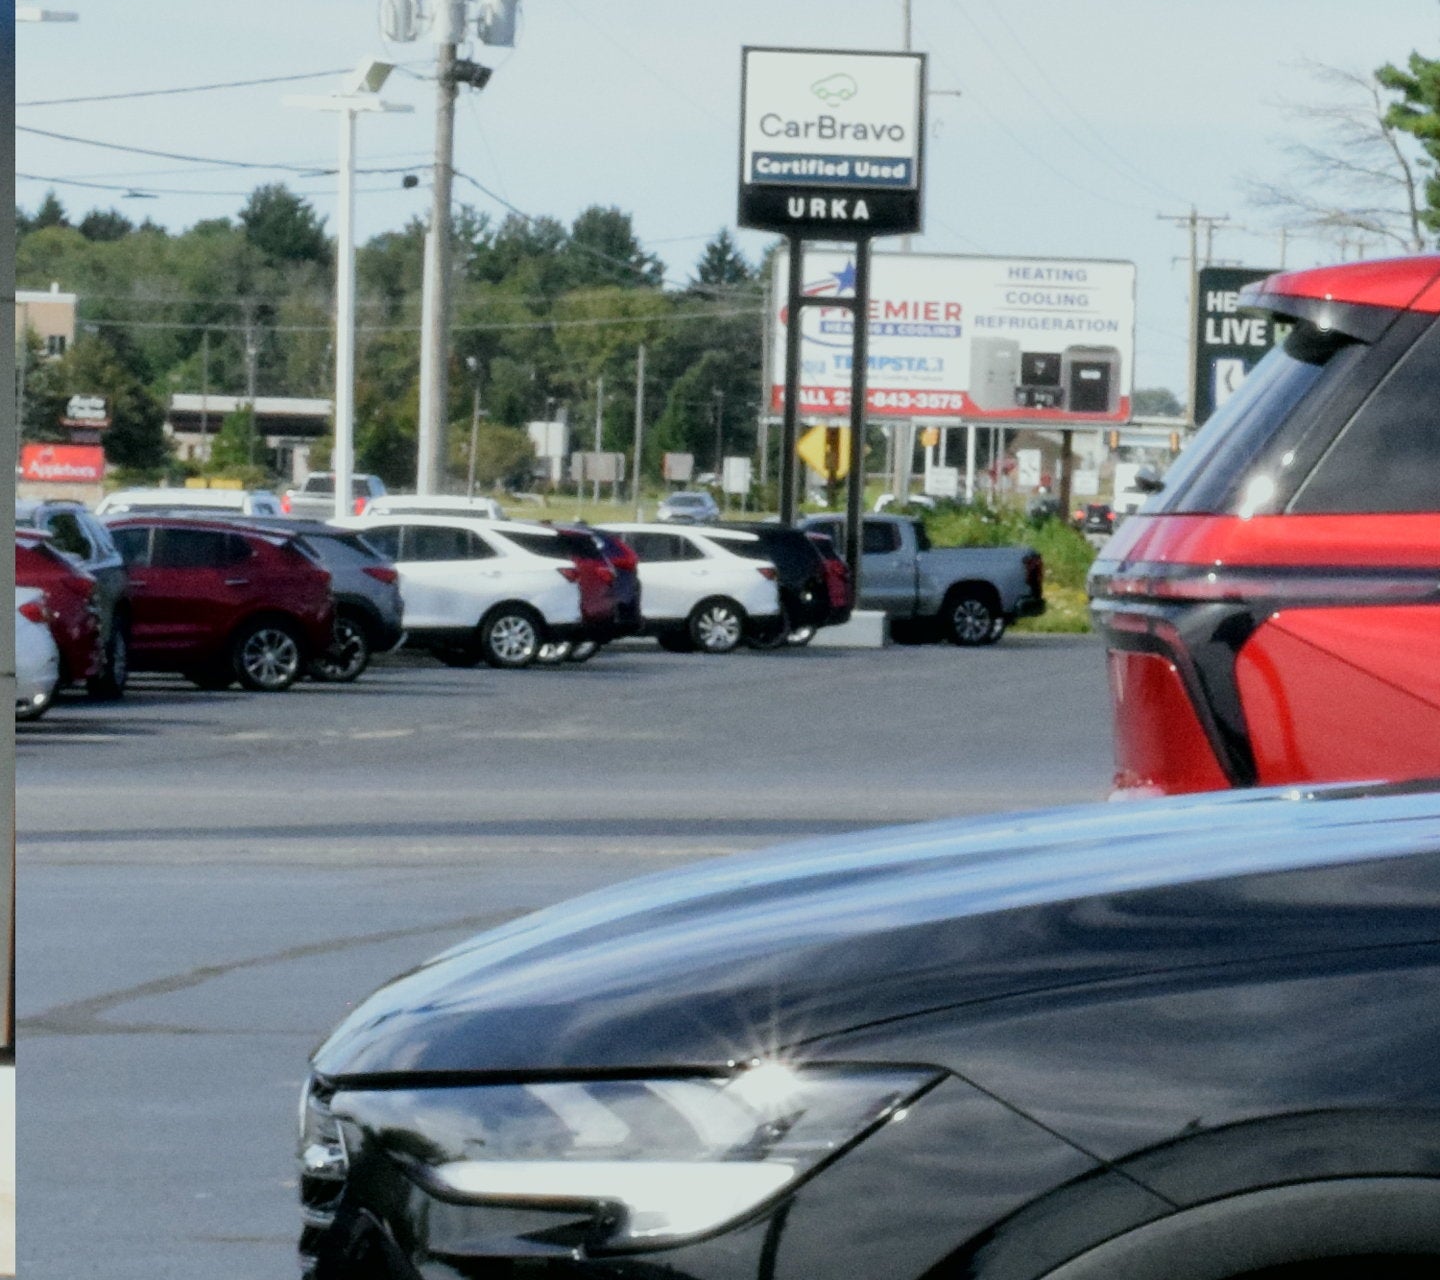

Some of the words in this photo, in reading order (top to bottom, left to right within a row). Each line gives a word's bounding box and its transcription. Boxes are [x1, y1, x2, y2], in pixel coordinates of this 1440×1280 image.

[759, 112, 905, 142] CarBravo
[756, 157, 849, 176] Certified
[854, 161, 906, 179] Used
[787, 196, 870, 220] URKA
[1007, 266, 1088, 282] HEATING
[1005, 291, 1090, 307] COOLING
[974, 315, 1119, 332] REFRIGERATION
[1205, 318, 1267, 346] LIVE
[779, 389, 830, 406] ALL
[832, 389, 963, 409] 2-843-3575
